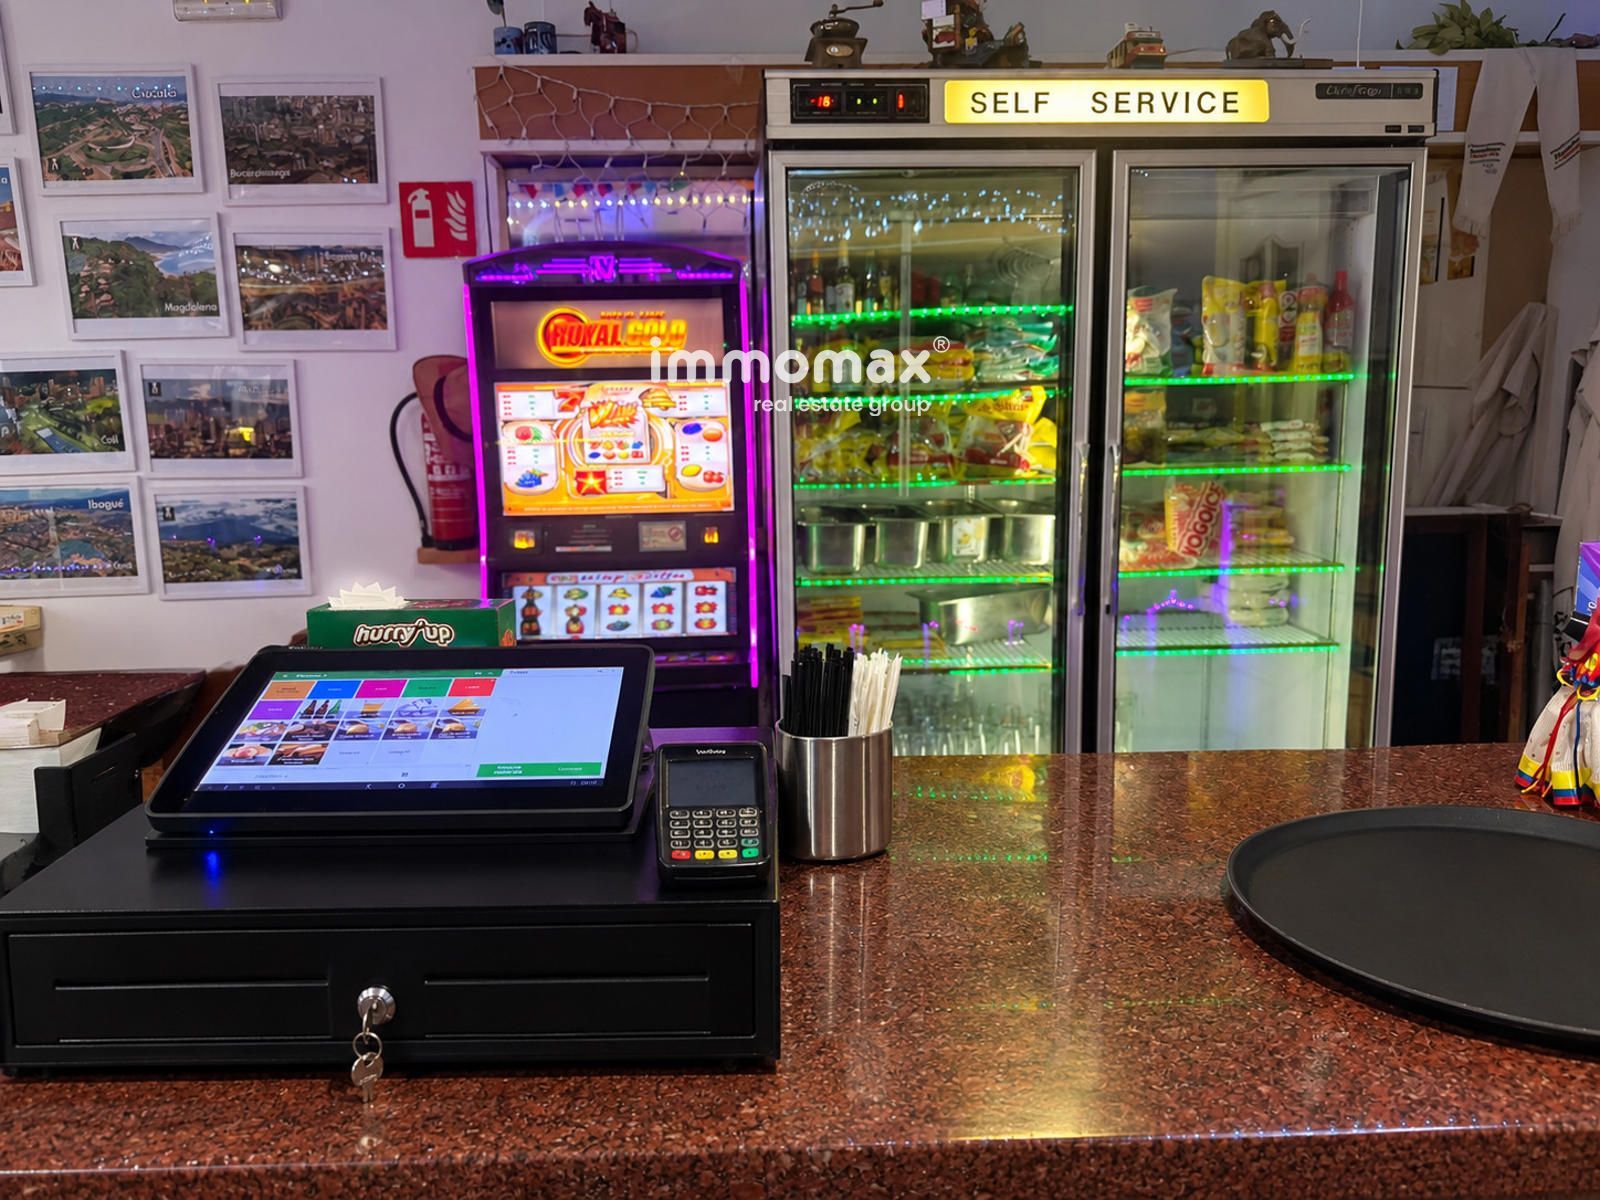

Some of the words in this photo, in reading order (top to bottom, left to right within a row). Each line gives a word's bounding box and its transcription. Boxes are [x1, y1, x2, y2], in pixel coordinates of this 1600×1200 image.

[970, 92, 1050, 114] SELF
[1090, 92, 1240, 114] SERVICE
[164, 302, 217, 314] Magdalena
[550, 323, 621, 348] ROYAL
